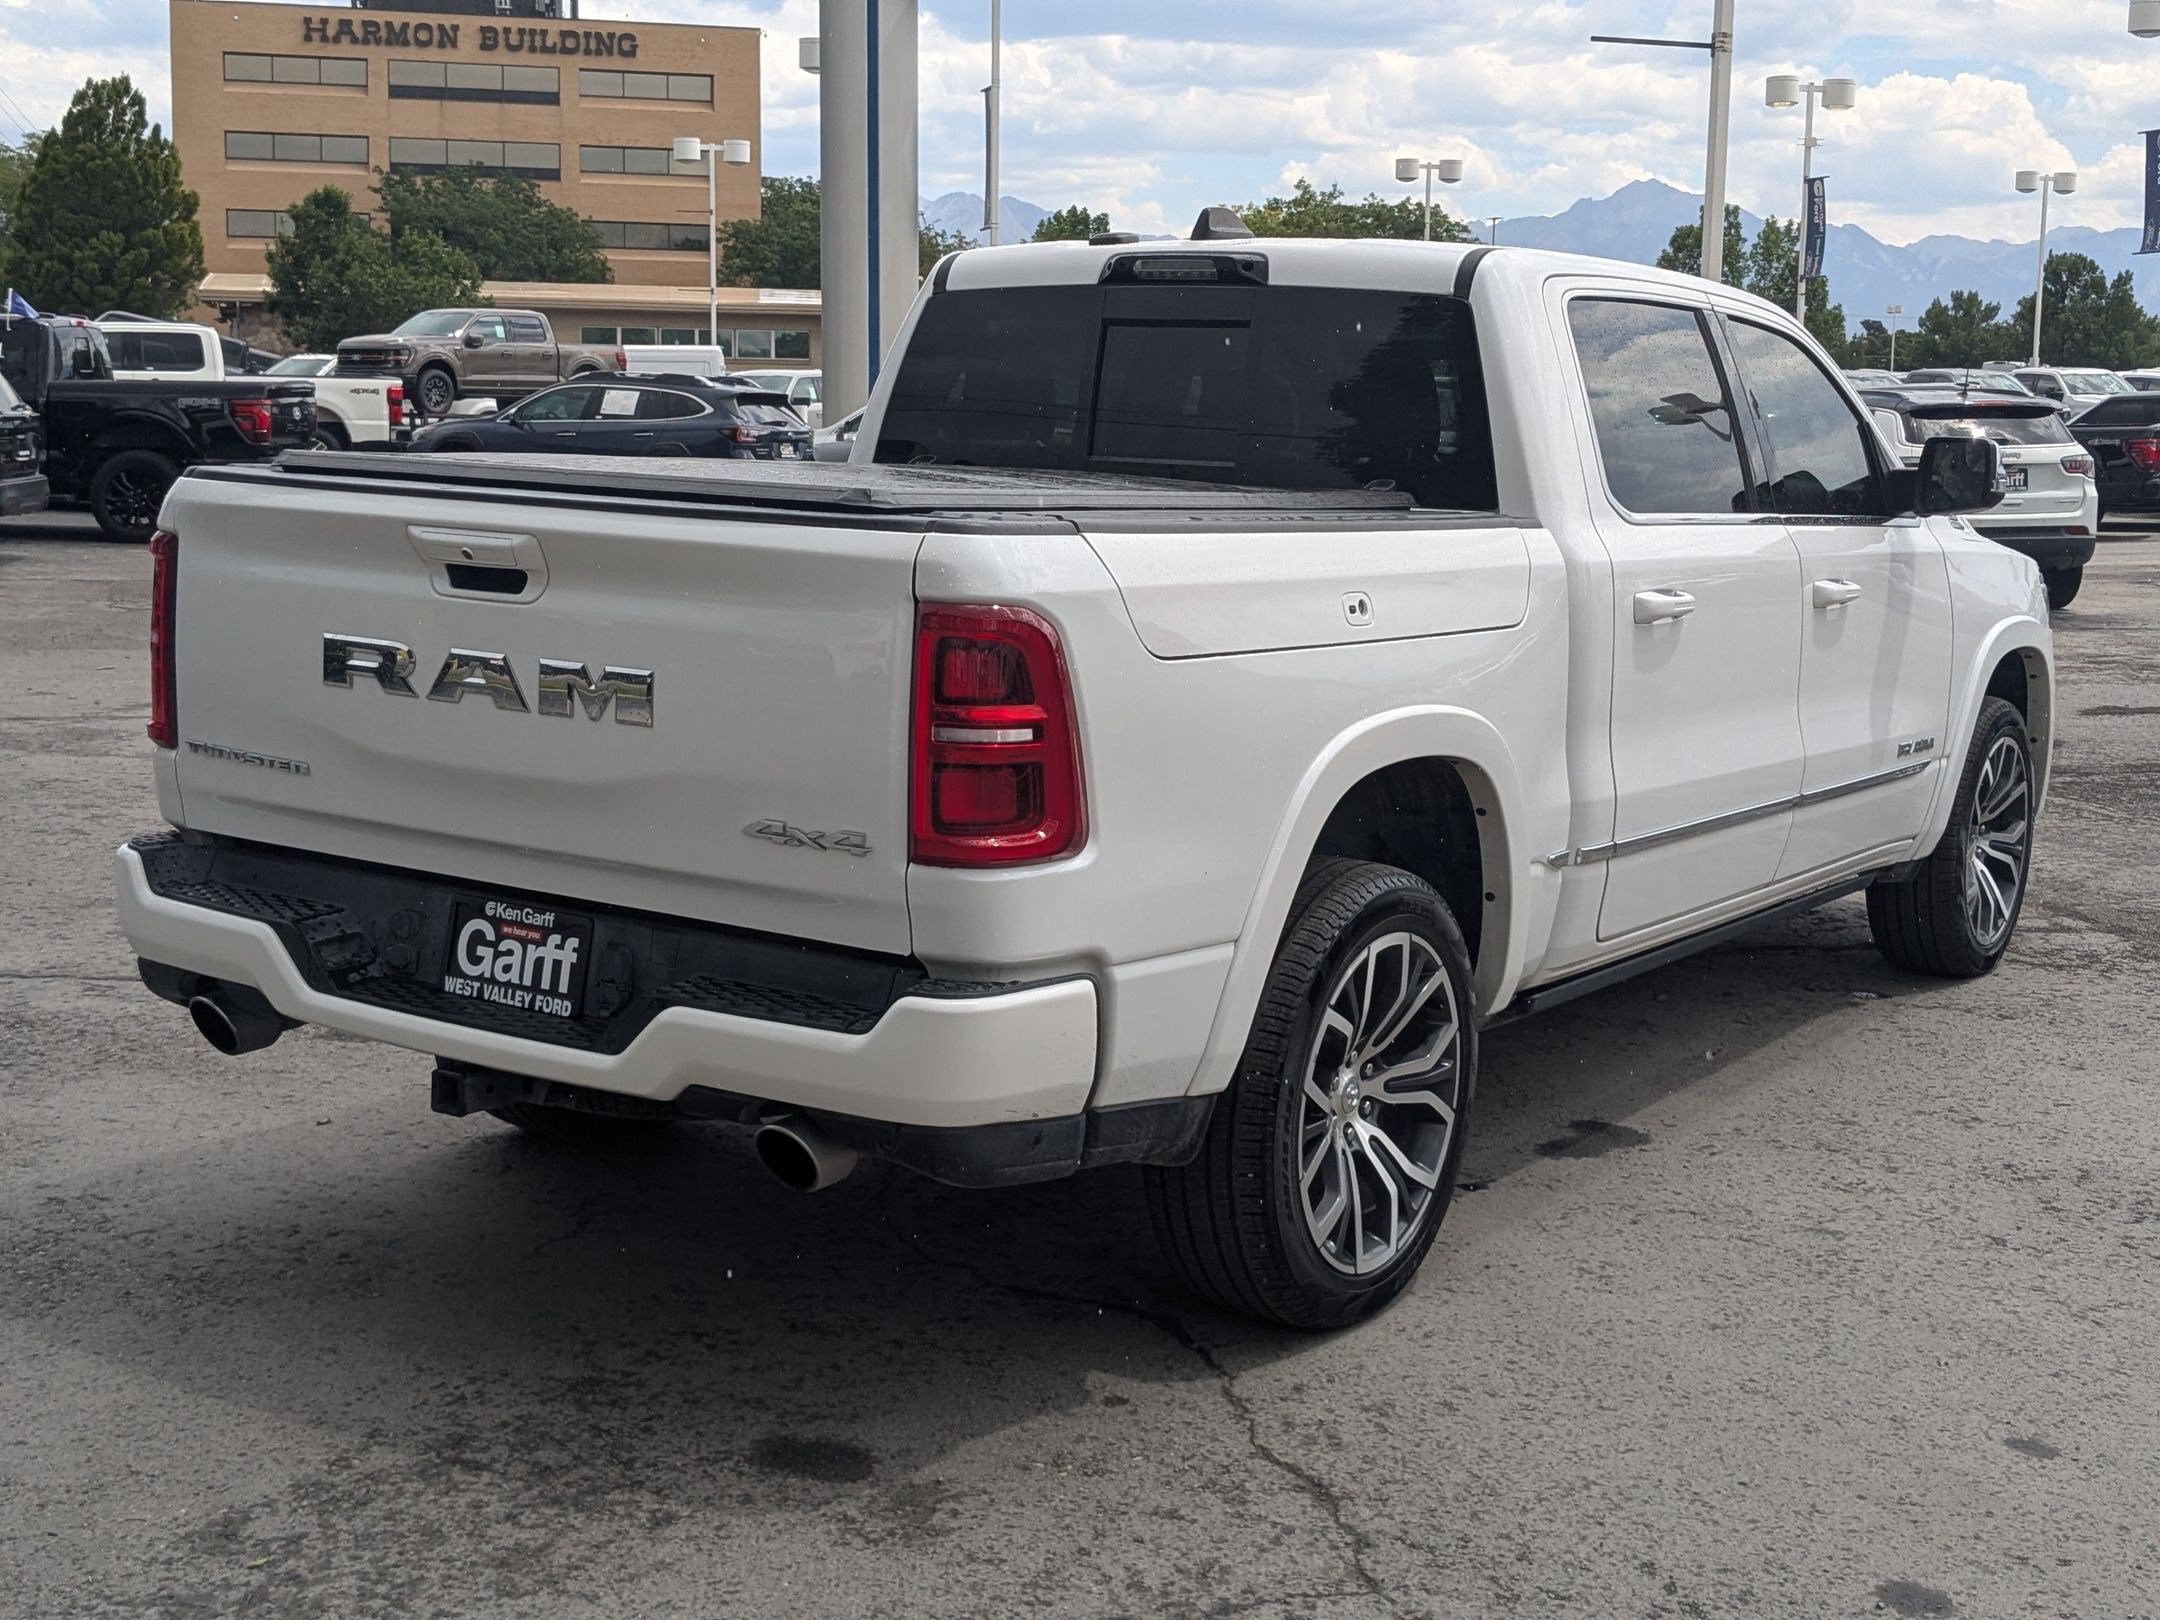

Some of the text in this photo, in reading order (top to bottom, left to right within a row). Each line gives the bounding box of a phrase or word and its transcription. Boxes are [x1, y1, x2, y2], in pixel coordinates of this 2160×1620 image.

[303, 17, 639, 58] HARMON BUILDING
[322, 631, 655, 729] RAM
[495, 902, 556, 928] Ken Garff
[457, 918, 580, 994] Garff
[444, 975, 572, 1017] WEST VALLEY FORD
